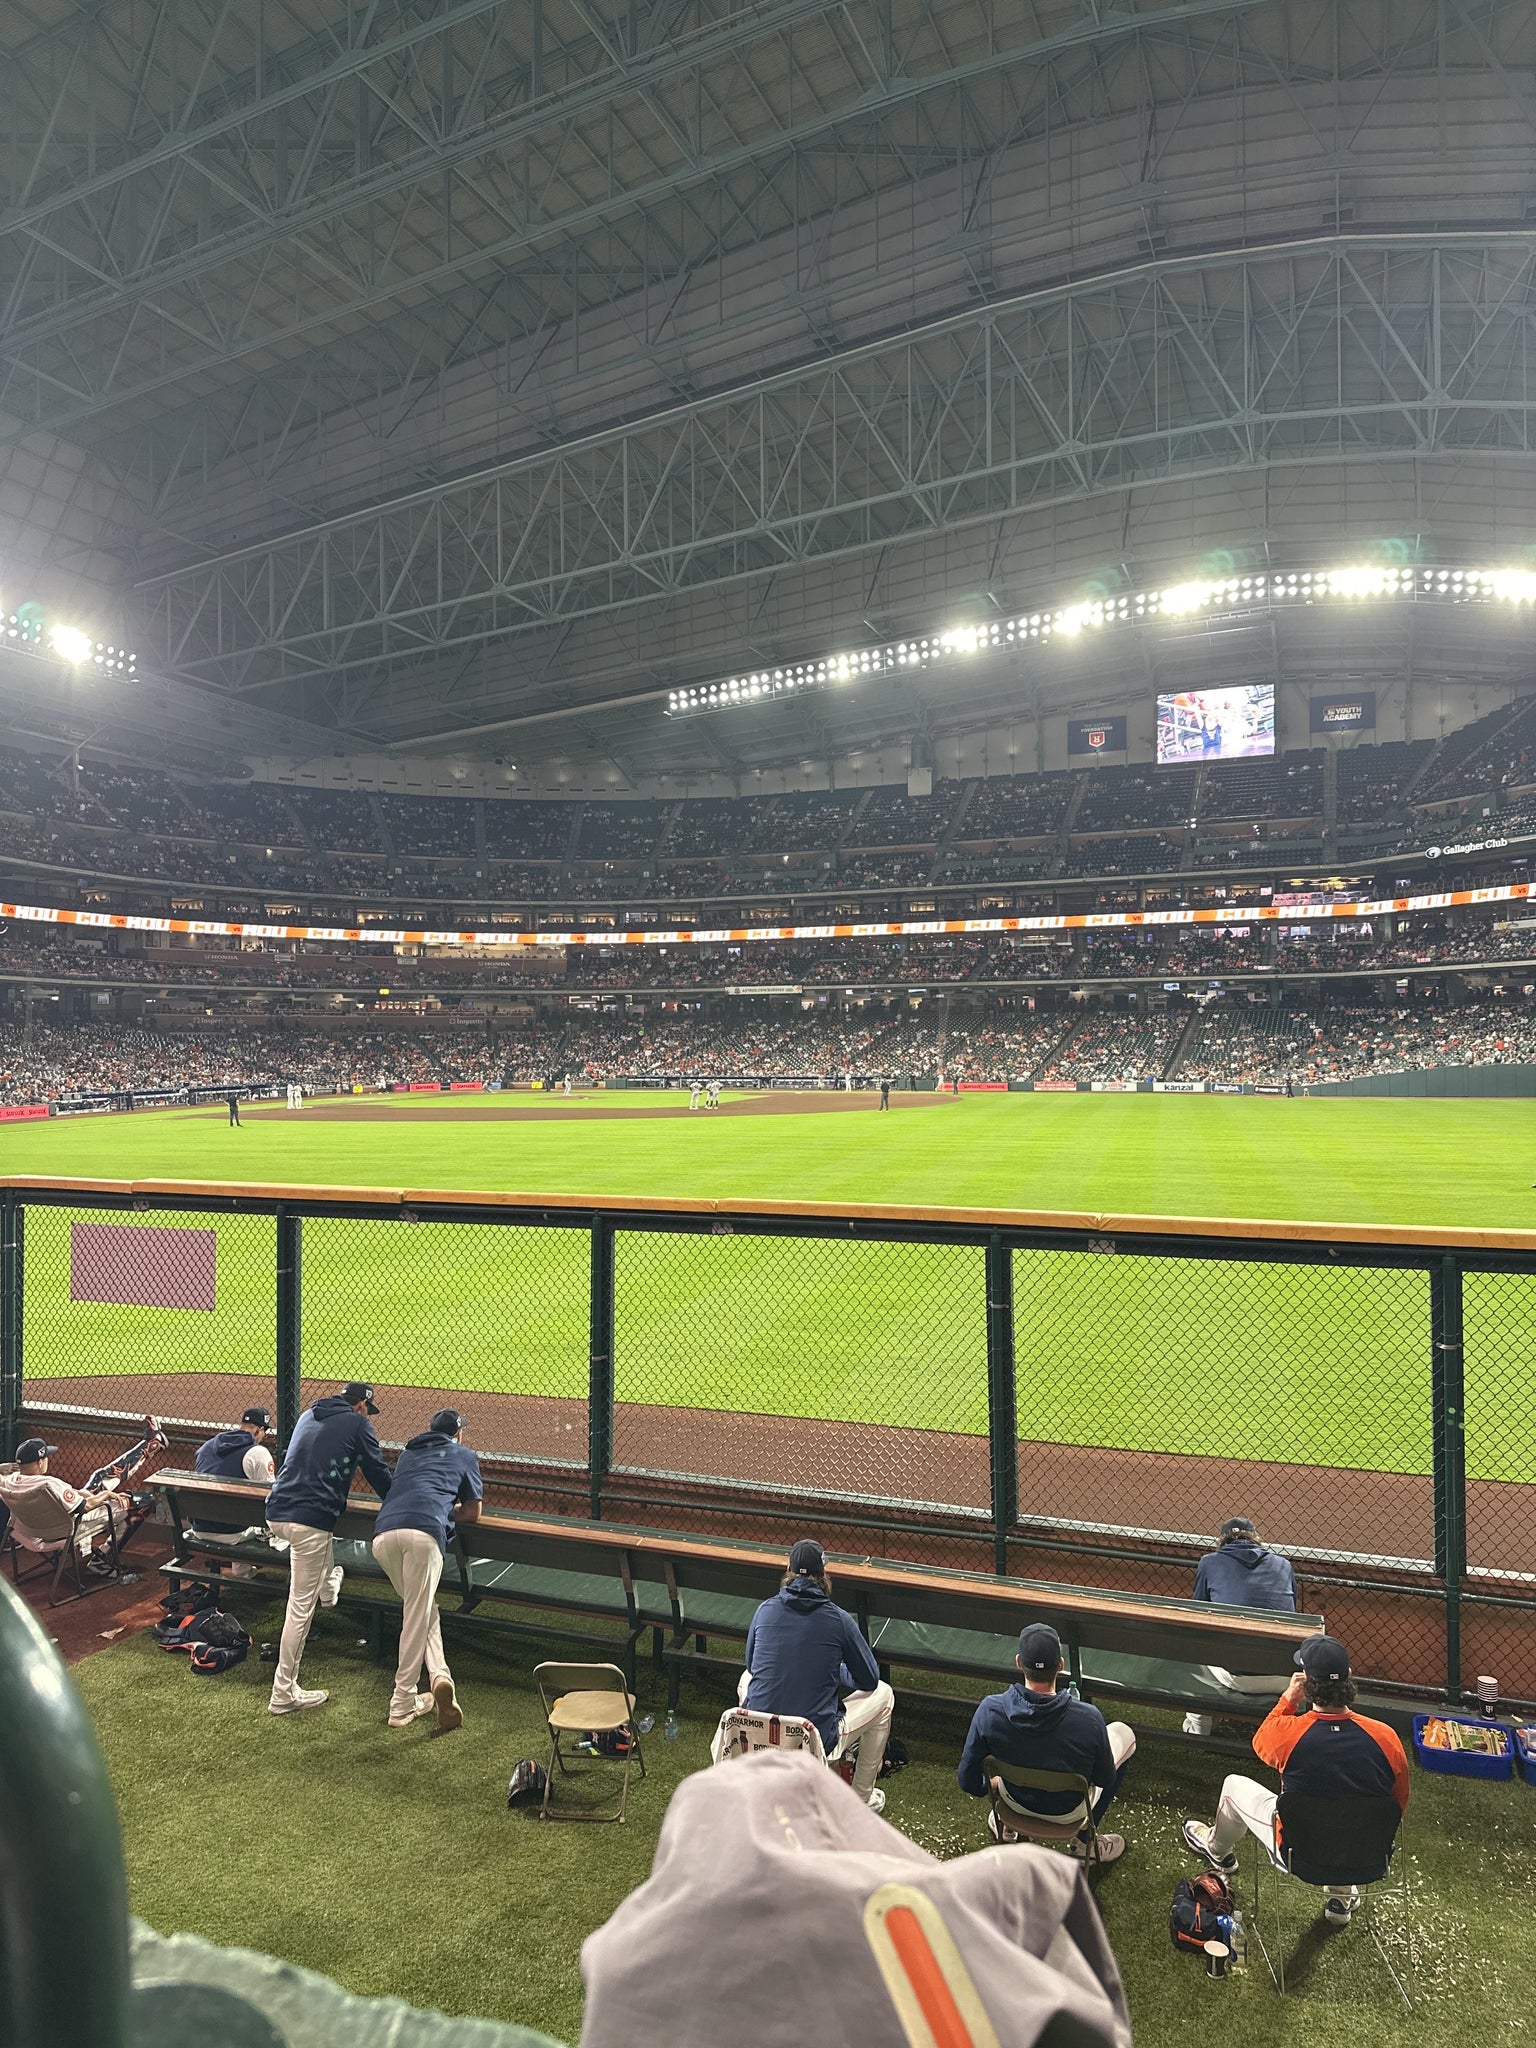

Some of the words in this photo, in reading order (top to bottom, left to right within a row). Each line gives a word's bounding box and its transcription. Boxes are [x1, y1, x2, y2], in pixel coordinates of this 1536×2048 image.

[1323, 712, 1362, 721] ACADEMY
[1442, 842, 1484, 854] Gallagher
[1484, 838, 1508, 848] Club
